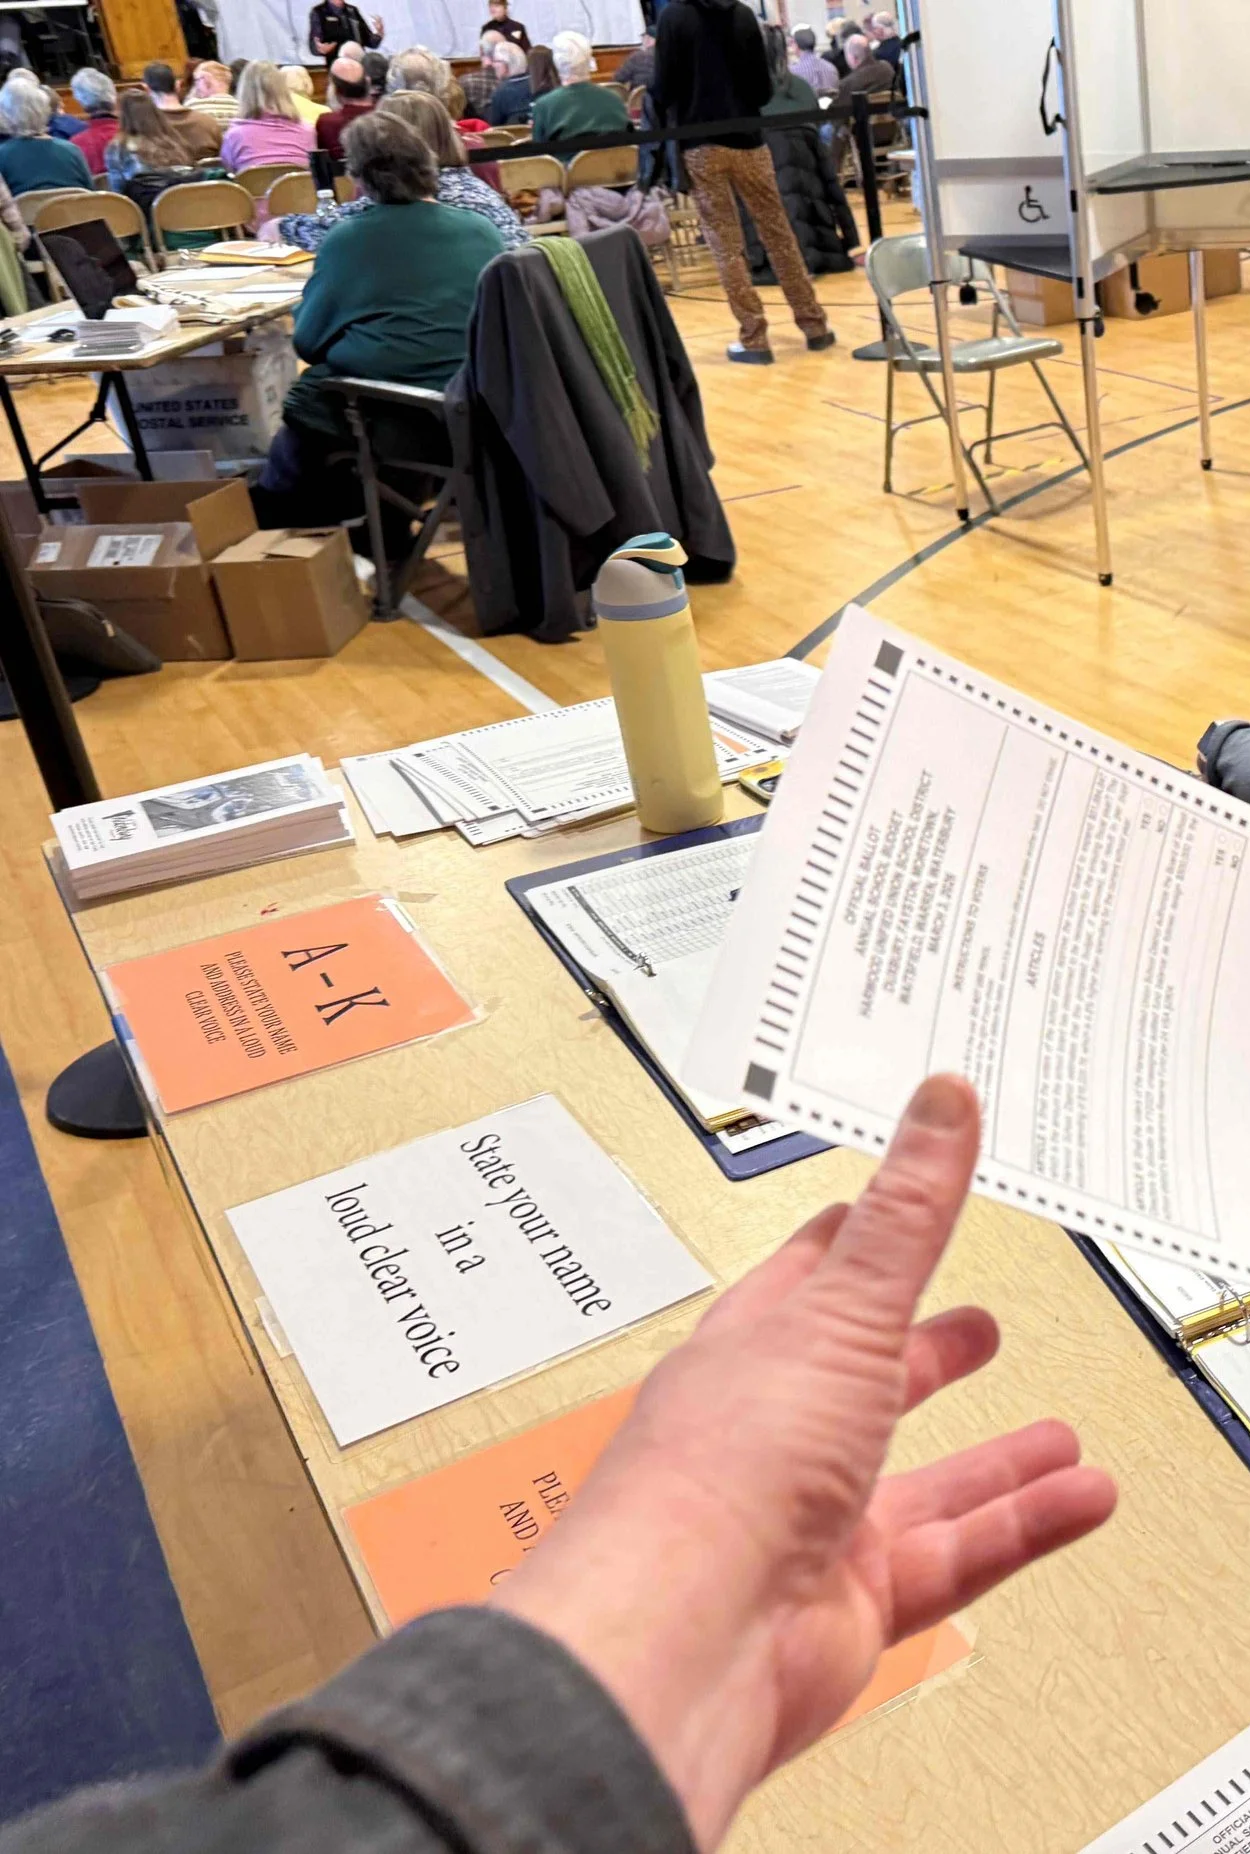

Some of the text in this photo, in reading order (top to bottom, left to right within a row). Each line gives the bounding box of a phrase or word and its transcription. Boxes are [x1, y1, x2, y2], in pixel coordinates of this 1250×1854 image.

[842, 823, 881, 926] OFFICIAL BALLOT
[928, 804, 956, 880] WATERBURY
[852, 808, 904, 956] ANNUAL SCHOOL BUDGET
[857, 767, 934, 1018] HARWOOD UNIFIED UNION SCHOOL DISTRICT
[967, 902, 979, 919] TO
[927, 910, 947, 954] MARCH
[1024, 929, 1045, 988] ARTICLES
[183, 989, 227, 1045] CLEAR VOICE
[199, 961, 267, 1059] AND ADDRESS IN A LOUD
[222, 950, 299, 1055] PLEASE STATE YOUR NAME
[281, 943, 349, 972] A
[315, 986, 391, 1026] K
[434, 1220, 486, 1275] in a
[460, 1133, 612, 1317] State your name
[324, 1182, 460, 1379] loud clear voice
[499, 1500, 540, 1543] AND
[532, 1471, 571, 1521] PLE
